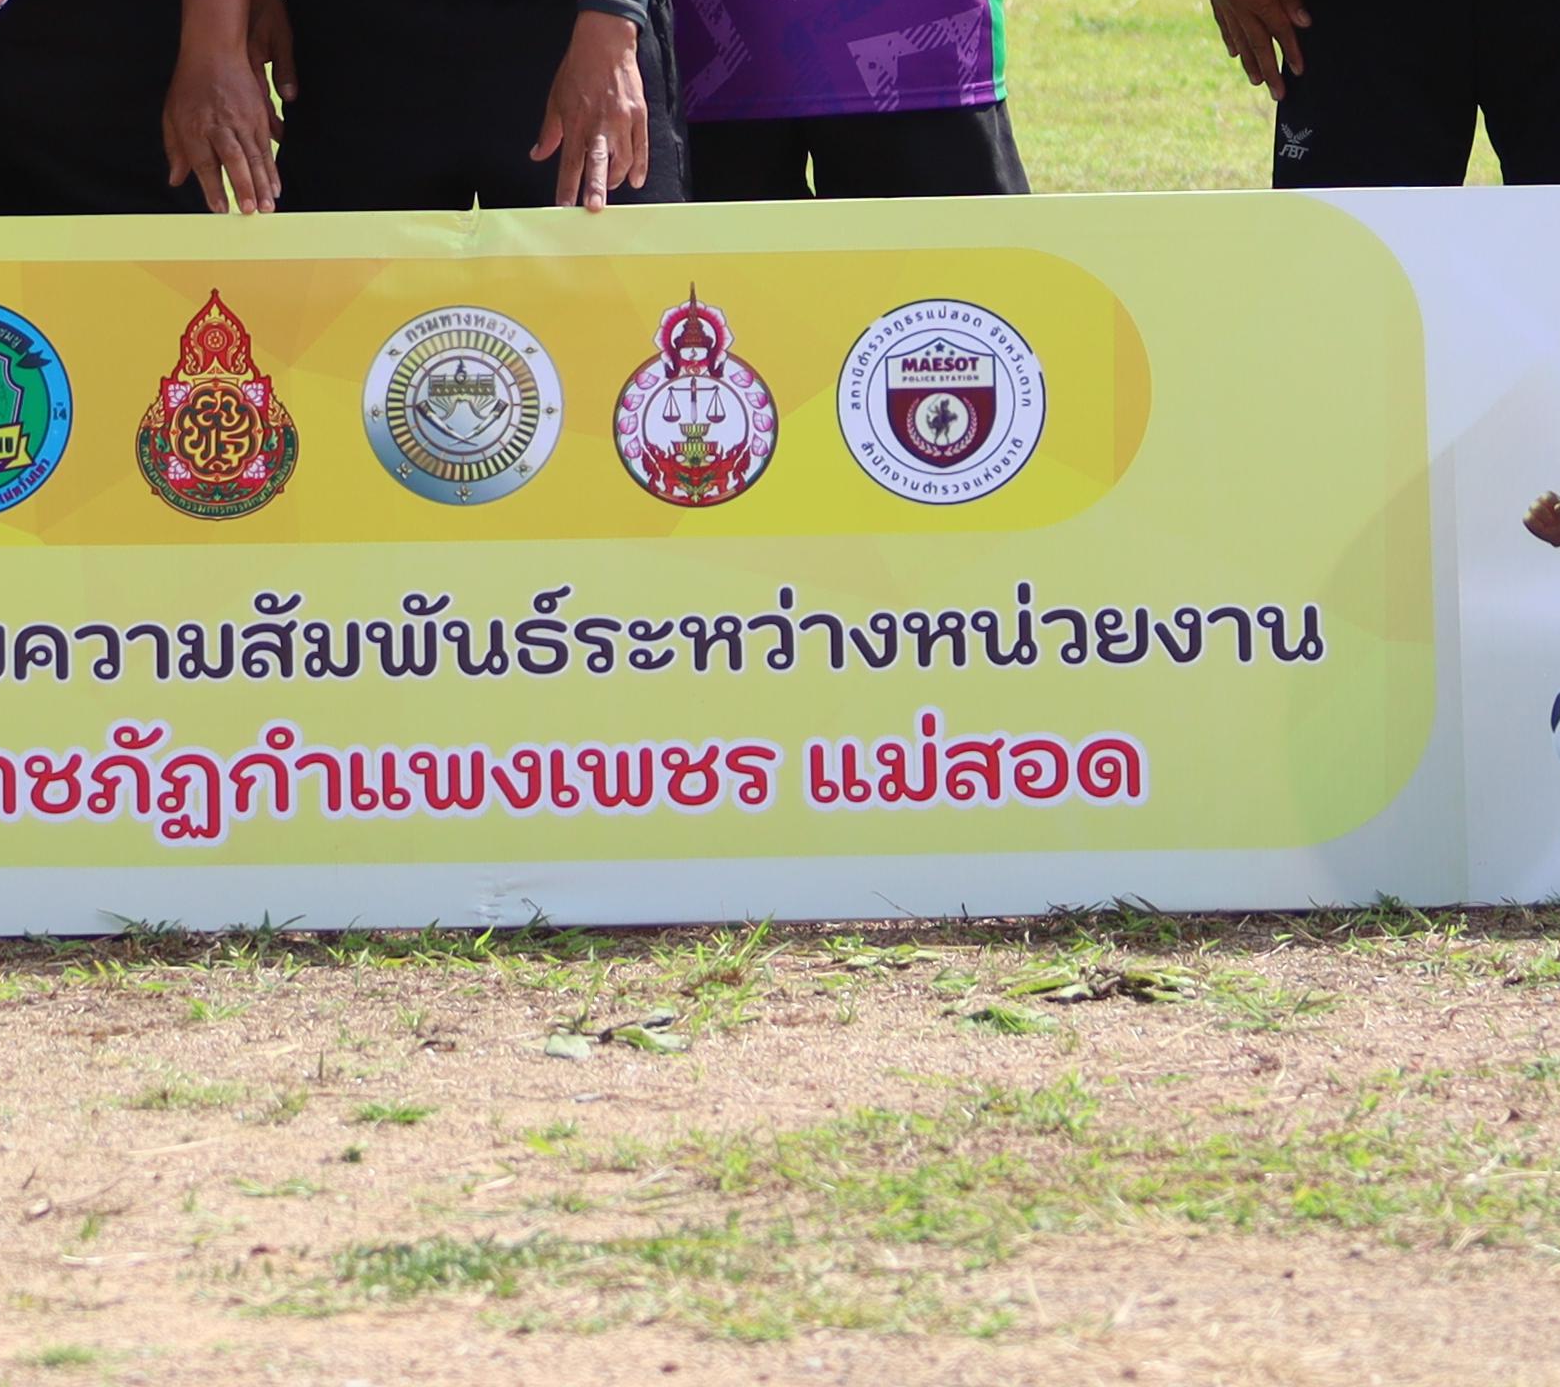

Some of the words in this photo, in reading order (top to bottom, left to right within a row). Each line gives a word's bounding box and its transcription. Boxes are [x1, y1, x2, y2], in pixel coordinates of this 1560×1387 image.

[404, 312, 517, 344] กรมทางหลวง
[901, 357, 980, 373] MAESOT
[810, 714, 1140, 804] แม่สอด
